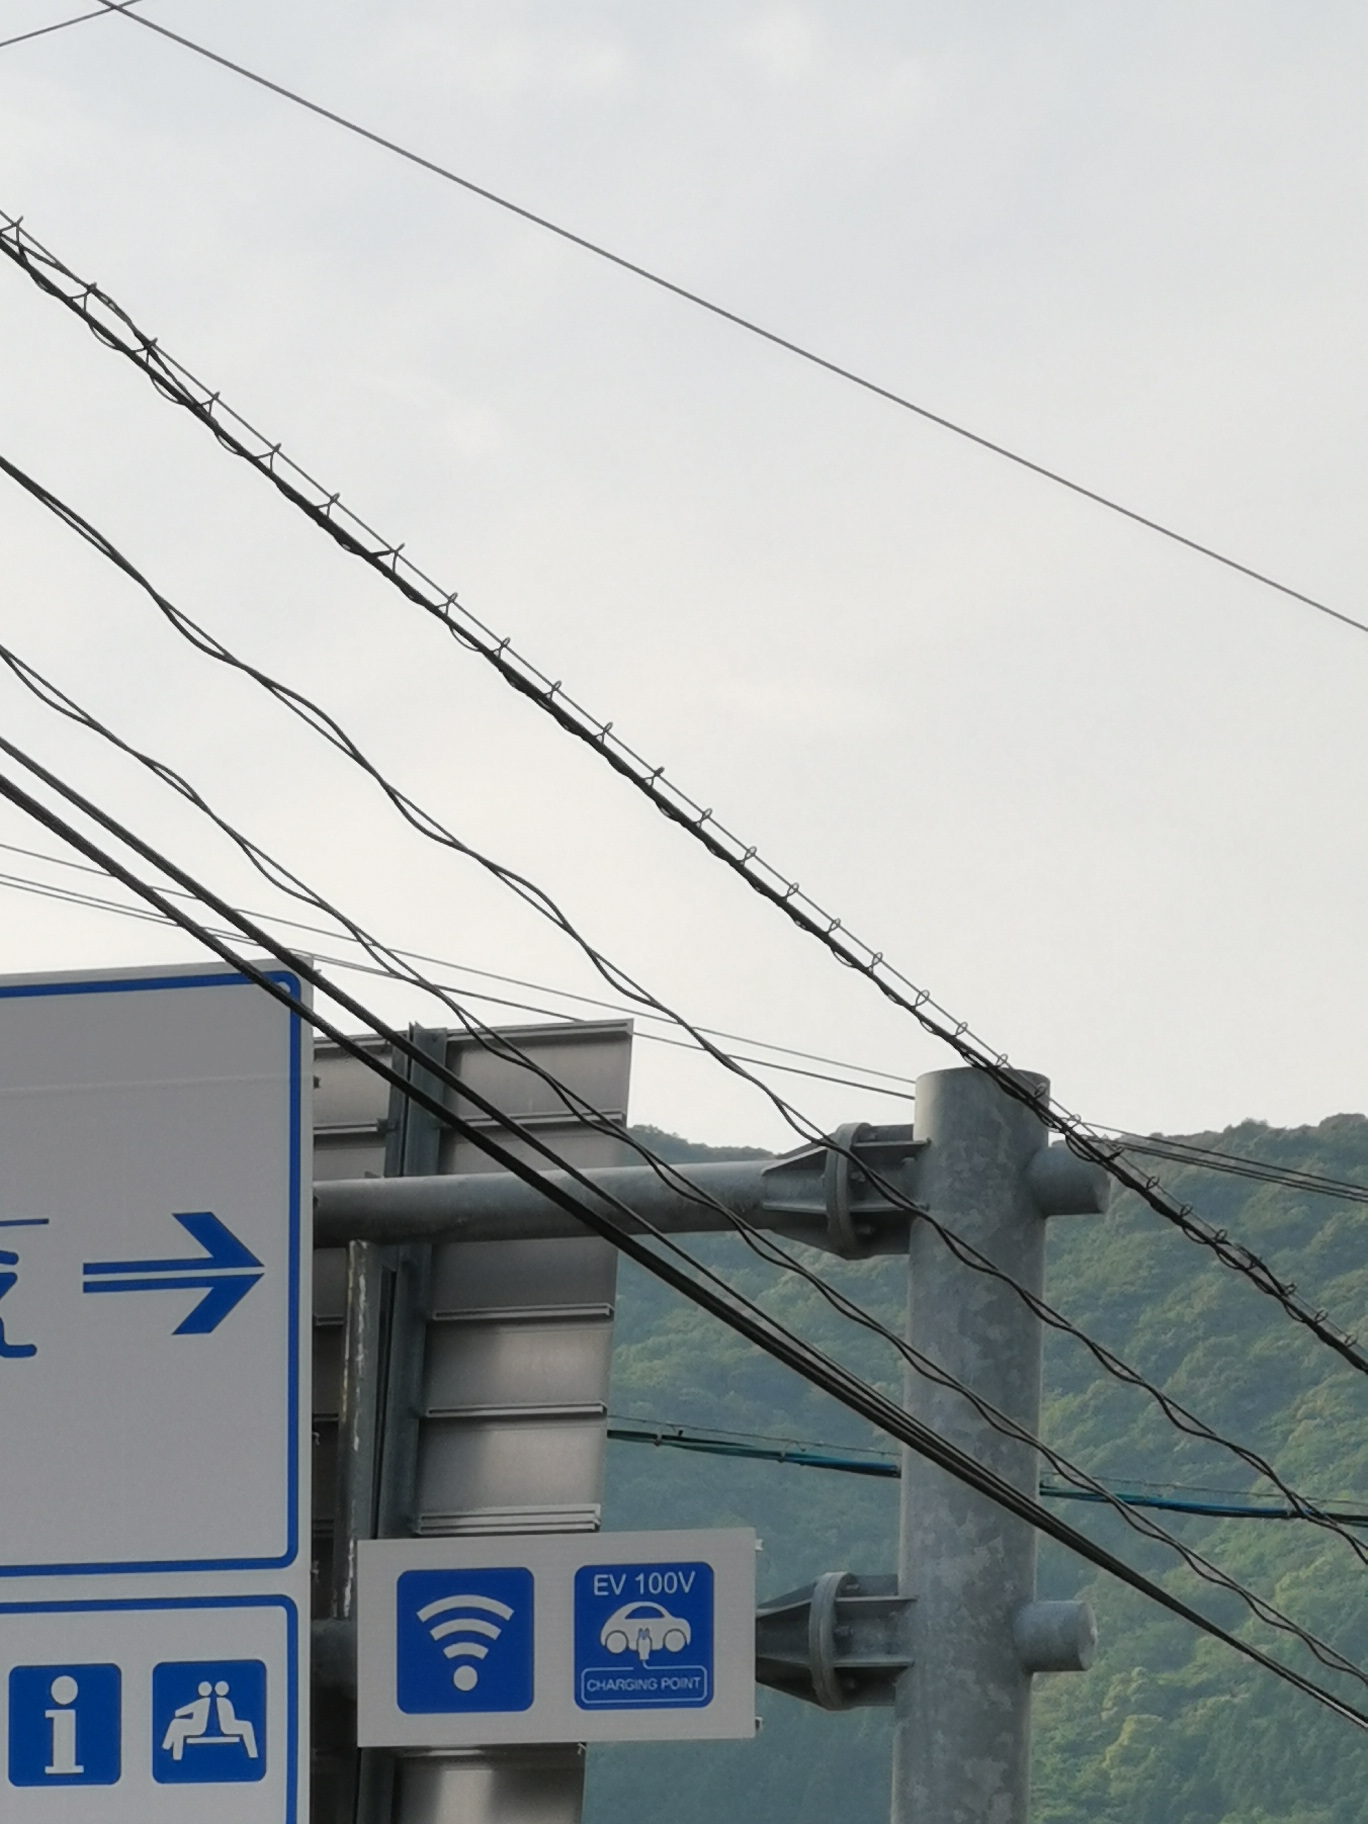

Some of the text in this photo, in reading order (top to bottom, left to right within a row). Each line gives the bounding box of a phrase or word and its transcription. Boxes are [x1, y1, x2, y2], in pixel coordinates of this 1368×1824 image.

[593, 1570, 696, 1596] EV 100V
[586, 1676, 702, 1692] CHARGING POINT
